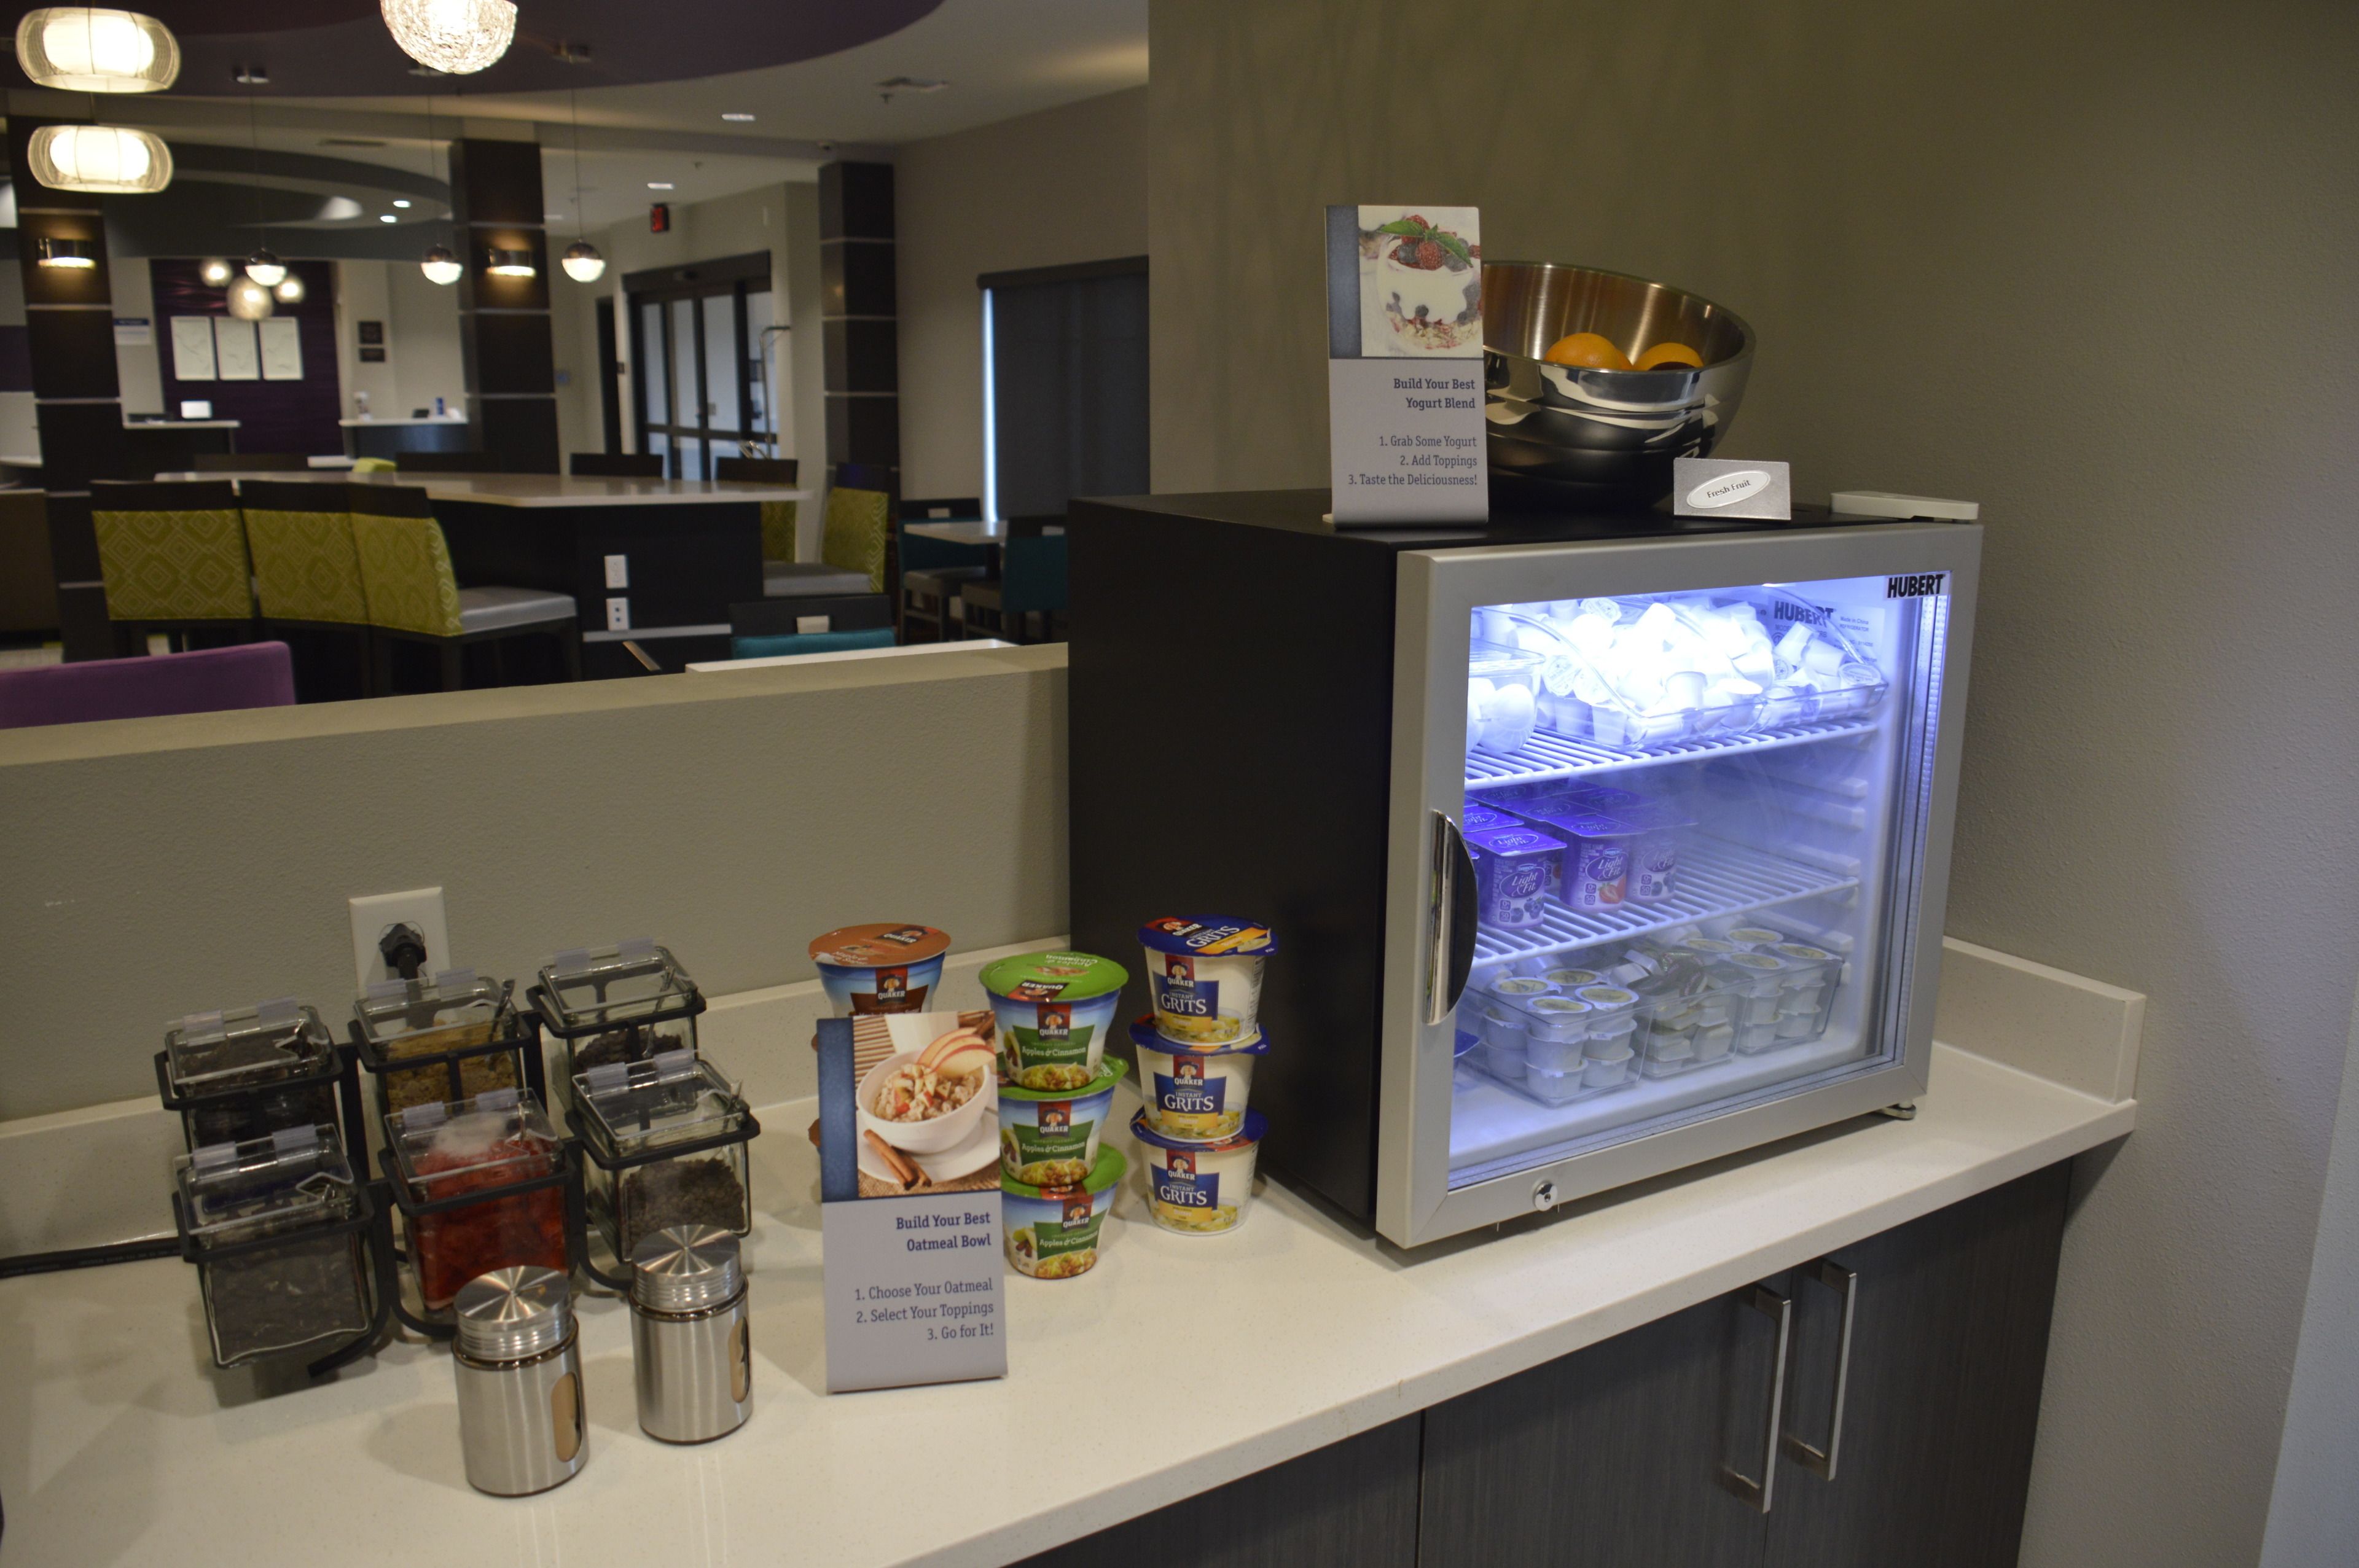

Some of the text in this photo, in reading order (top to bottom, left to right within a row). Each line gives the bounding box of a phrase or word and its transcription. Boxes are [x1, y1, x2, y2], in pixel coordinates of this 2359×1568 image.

[1393, 378, 1476, 390] Build Your Best
[1406, 397, 1476, 411] Yogurt Blend
[1380, 435, 1477, 450] 1. Grab Some Yogurt
[1400, 454, 1477, 469] 2. Add Toppings
[1348, 474, 1477, 486] 3. Taste the Deliciousness!
[1707, 479, 1751, 499] Fresh Fruit
[1887, 574, 1944, 599] HUBERT
[1774, 601, 1834, 628] HUBERT
[1598, 856, 1622, 870] Light
[1511, 872, 1538, 886] Light
[1172, 923, 1203, 937] QUAKER
[1186, 926, 1240, 947] GRITS
[883, 933, 917, 944] QUAKER
[1022, 981, 1065, 990] QUAKER
[1167, 977, 1194, 988] QUAKER
[877, 990, 906, 1000] QUAKER
[1169, 991, 1194, 1000] INSTANT
[1160, 993, 1207, 1015] GRITS
[1039, 1028, 1069, 1037] QUAKER
[1022, 1045, 1045, 1056] Apples
[1052, 1046, 1087, 1056] Cinnamon
[1174, 1078, 1203, 1086] QUAKER
[1164, 1094, 1214, 1112] GRITS
[1039, 1125, 1069, 1134] QUAKER
[1022, 1143, 1044, 1153] Apples
[1052, 1141, 1086, 1152] Cinnamon
[1168, 1170, 1196, 1181] QUAKER
[1169, 1184, 1194, 1192] INSTANT
[1160, 1185, 1207, 1206] GRITS
[896, 1212, 991, 1230] Build Your Best
[1063, 1217, 1090, 1228] QUAKER
[907, 1233, 992, 1251] Oatmeal Bowl
[1039, 1238, 1063, 1248] Apples
[855, 1277, 993, 1301] 1. Choose Your Oatmeal
[856, 1301, 994, 1323] 2. Select Your Toppings
[928, 1323, 994, 1340] 3. Go for It!
